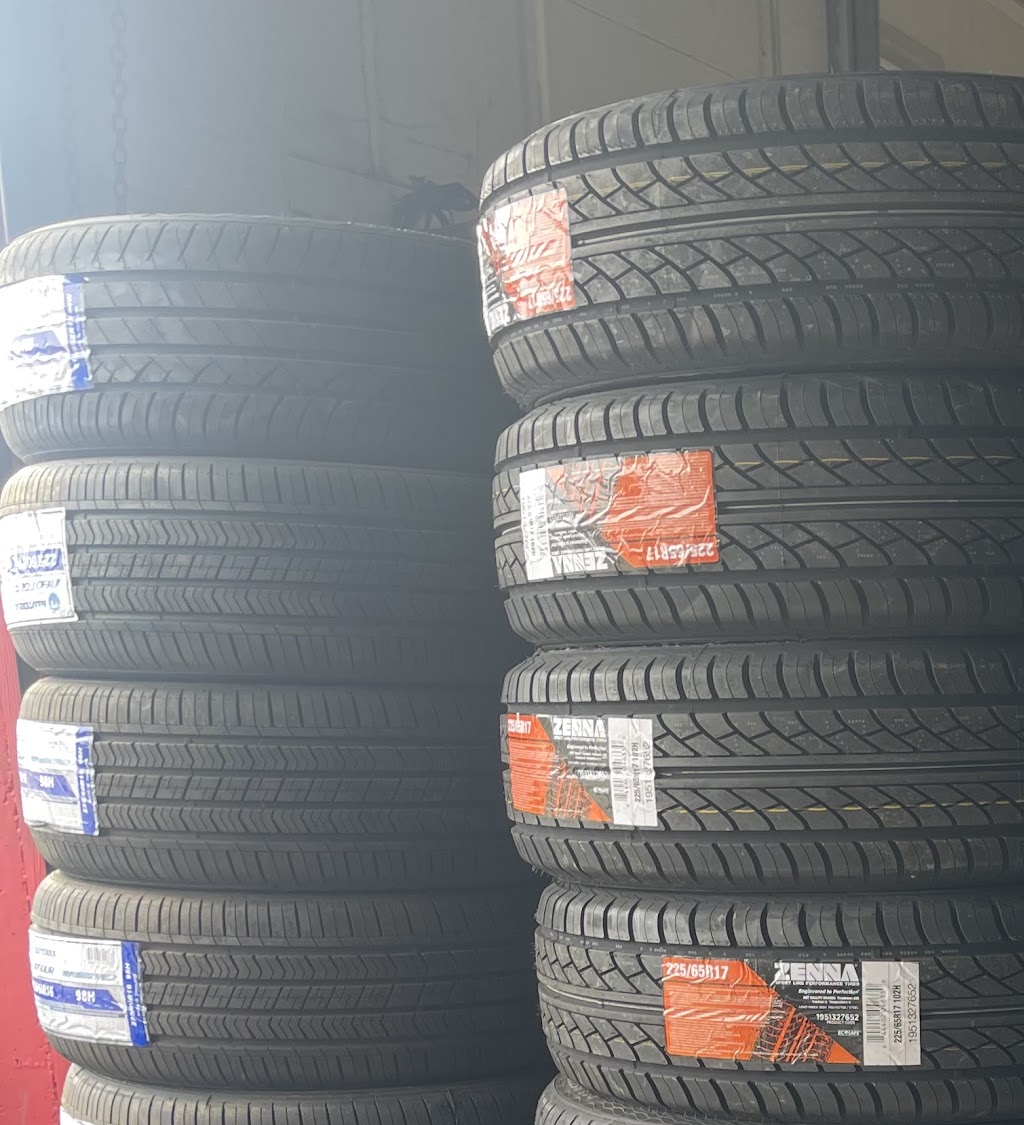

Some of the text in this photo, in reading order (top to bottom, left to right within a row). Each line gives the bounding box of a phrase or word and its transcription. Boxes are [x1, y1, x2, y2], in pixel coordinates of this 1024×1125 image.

[646, 542, 714, 562] 225/65R17
[553, 718, 607, 738] ZENNA
[666, 962, 729, 980] 225/65R17
[774, 962, 859, 982] ZENNA
[816, 1013, 859, 1022] 1951327652
[893, 984, 902, 1043] 225/65R17 102H
[907, 983, 918, 1044] 1951327652
